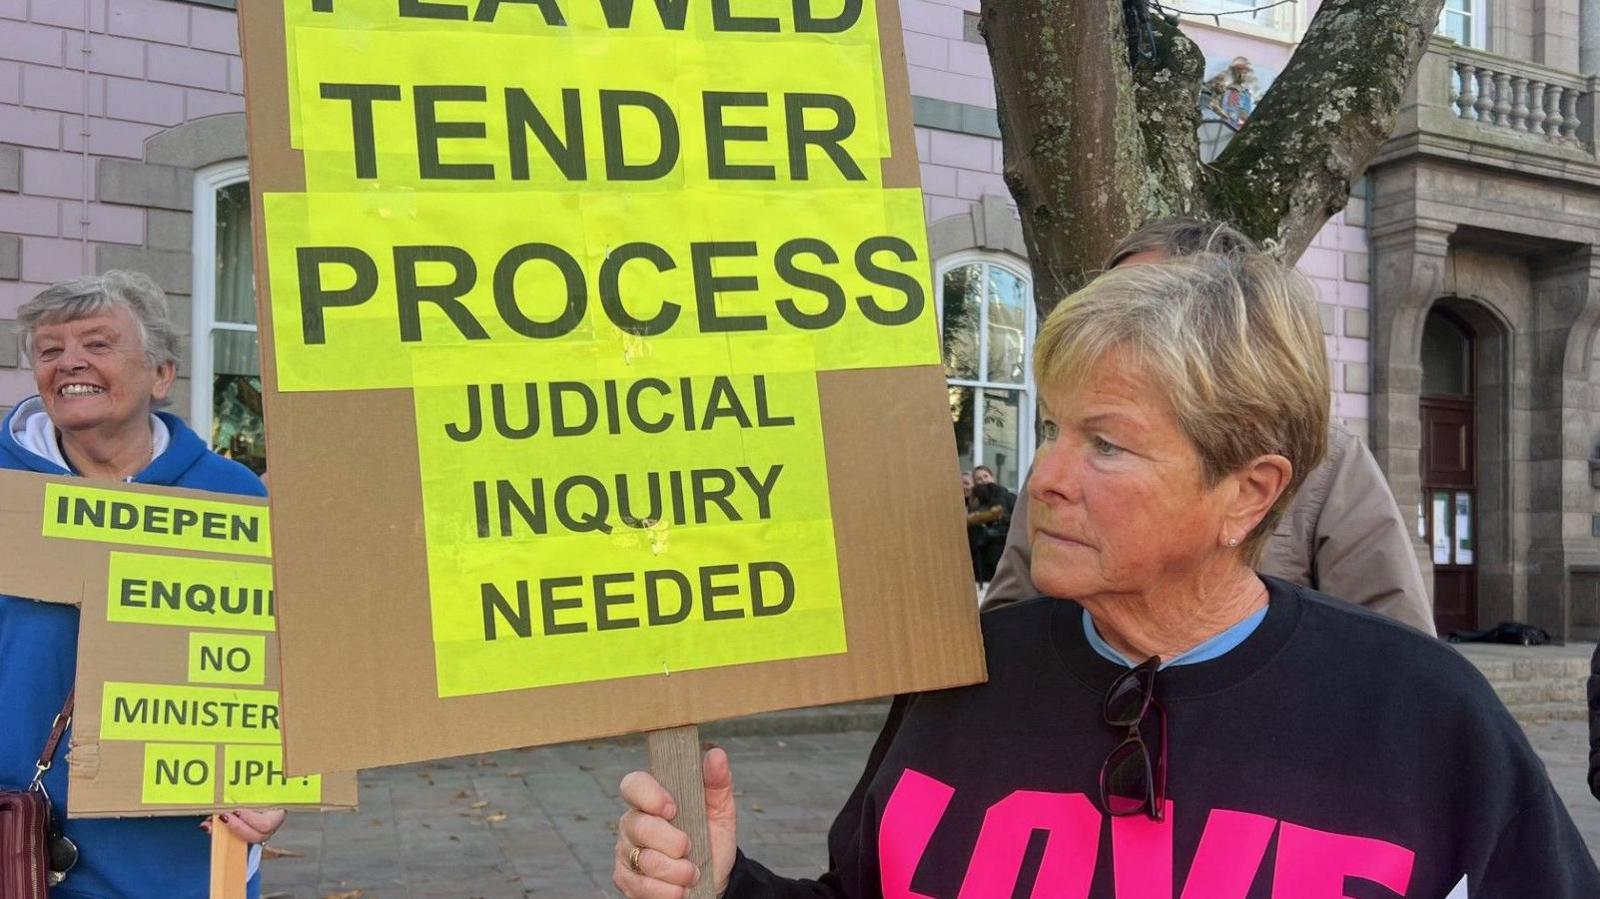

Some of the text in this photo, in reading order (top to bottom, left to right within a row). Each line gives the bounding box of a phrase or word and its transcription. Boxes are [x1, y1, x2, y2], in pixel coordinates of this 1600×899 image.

[320, 82, 868, 182] TENDER
[296, 235, 926, 345] PROCESS
[444, 374, 796, 443] JUDICIAL
[56, 495, 260, 543] INDEPEN
[473, 464, 784, 535] INQUIRY
[480, 560, 796, 641] NEEDED
[200, 646, 251, 673] NO
[114, 696, 280, 730] MINISTER
[155, 759, 209, 786] NO
